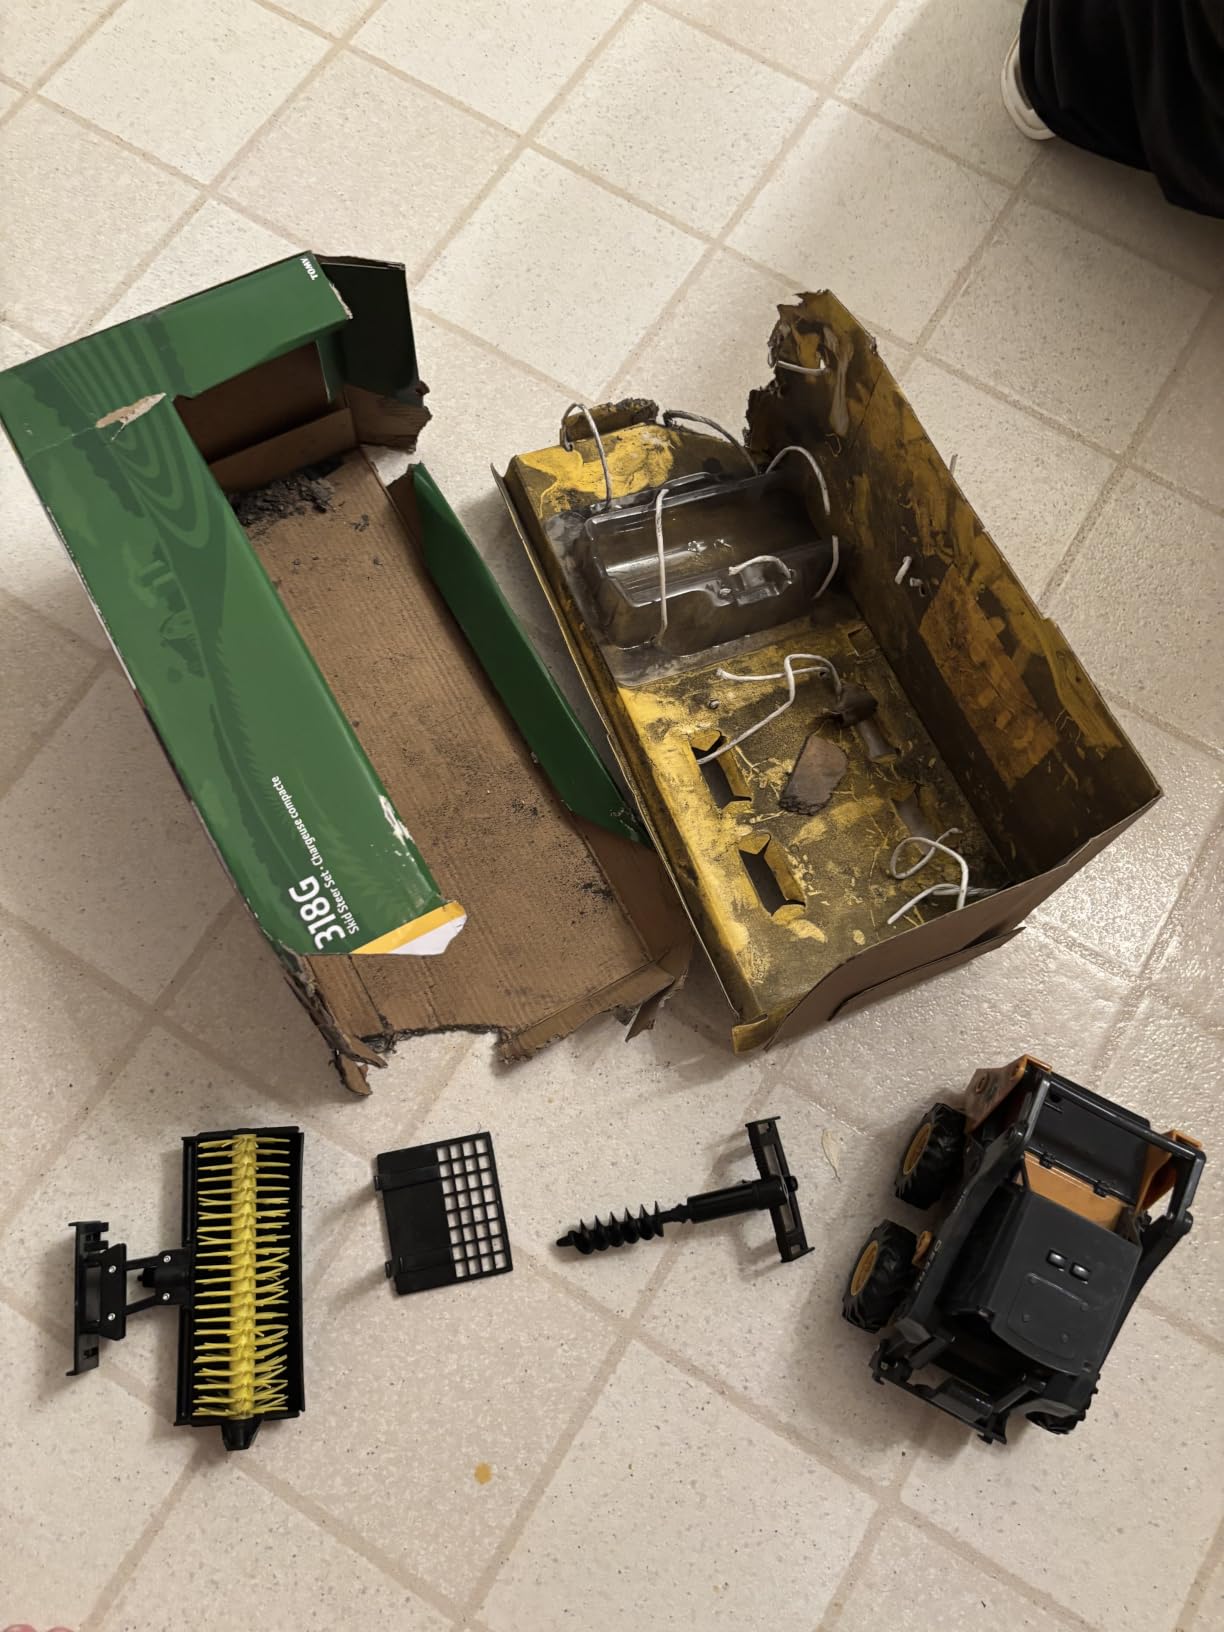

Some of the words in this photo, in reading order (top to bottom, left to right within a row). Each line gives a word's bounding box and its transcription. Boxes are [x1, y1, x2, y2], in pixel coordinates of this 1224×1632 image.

[300, 258, 319, 281] TOMY
[271, 775, 299, 819] compacte
[295, 818, 324, 866] Chargeuse
[321, 869, 336, 889] Set
[288, 875, 346, 950] 318G
[329, 887, 349, 914] Steer
[340, 912, 360, 935] Skid
